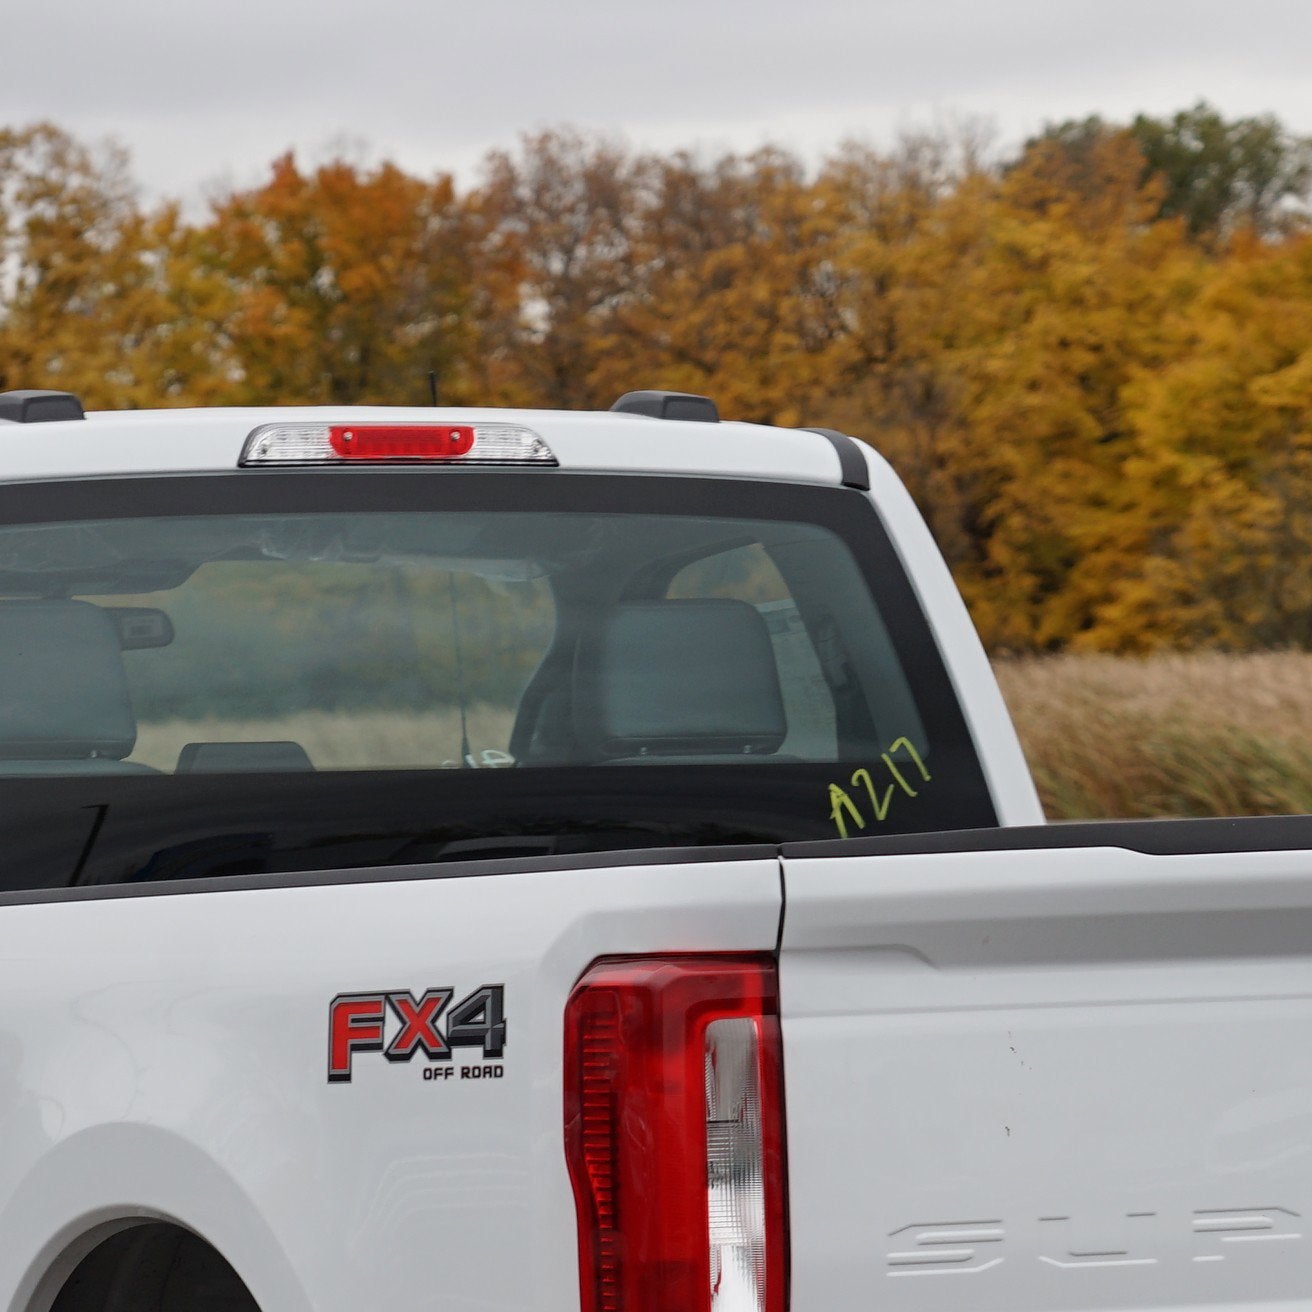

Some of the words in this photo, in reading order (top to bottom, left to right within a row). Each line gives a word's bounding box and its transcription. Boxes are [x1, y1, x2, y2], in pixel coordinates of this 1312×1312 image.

[828, 736, 932, 839] A217
[327, 983, 506, 1084] FX4
[423, 1067, 454, 1081] OFF
[461, 1065, 504, 1079] ROAD
